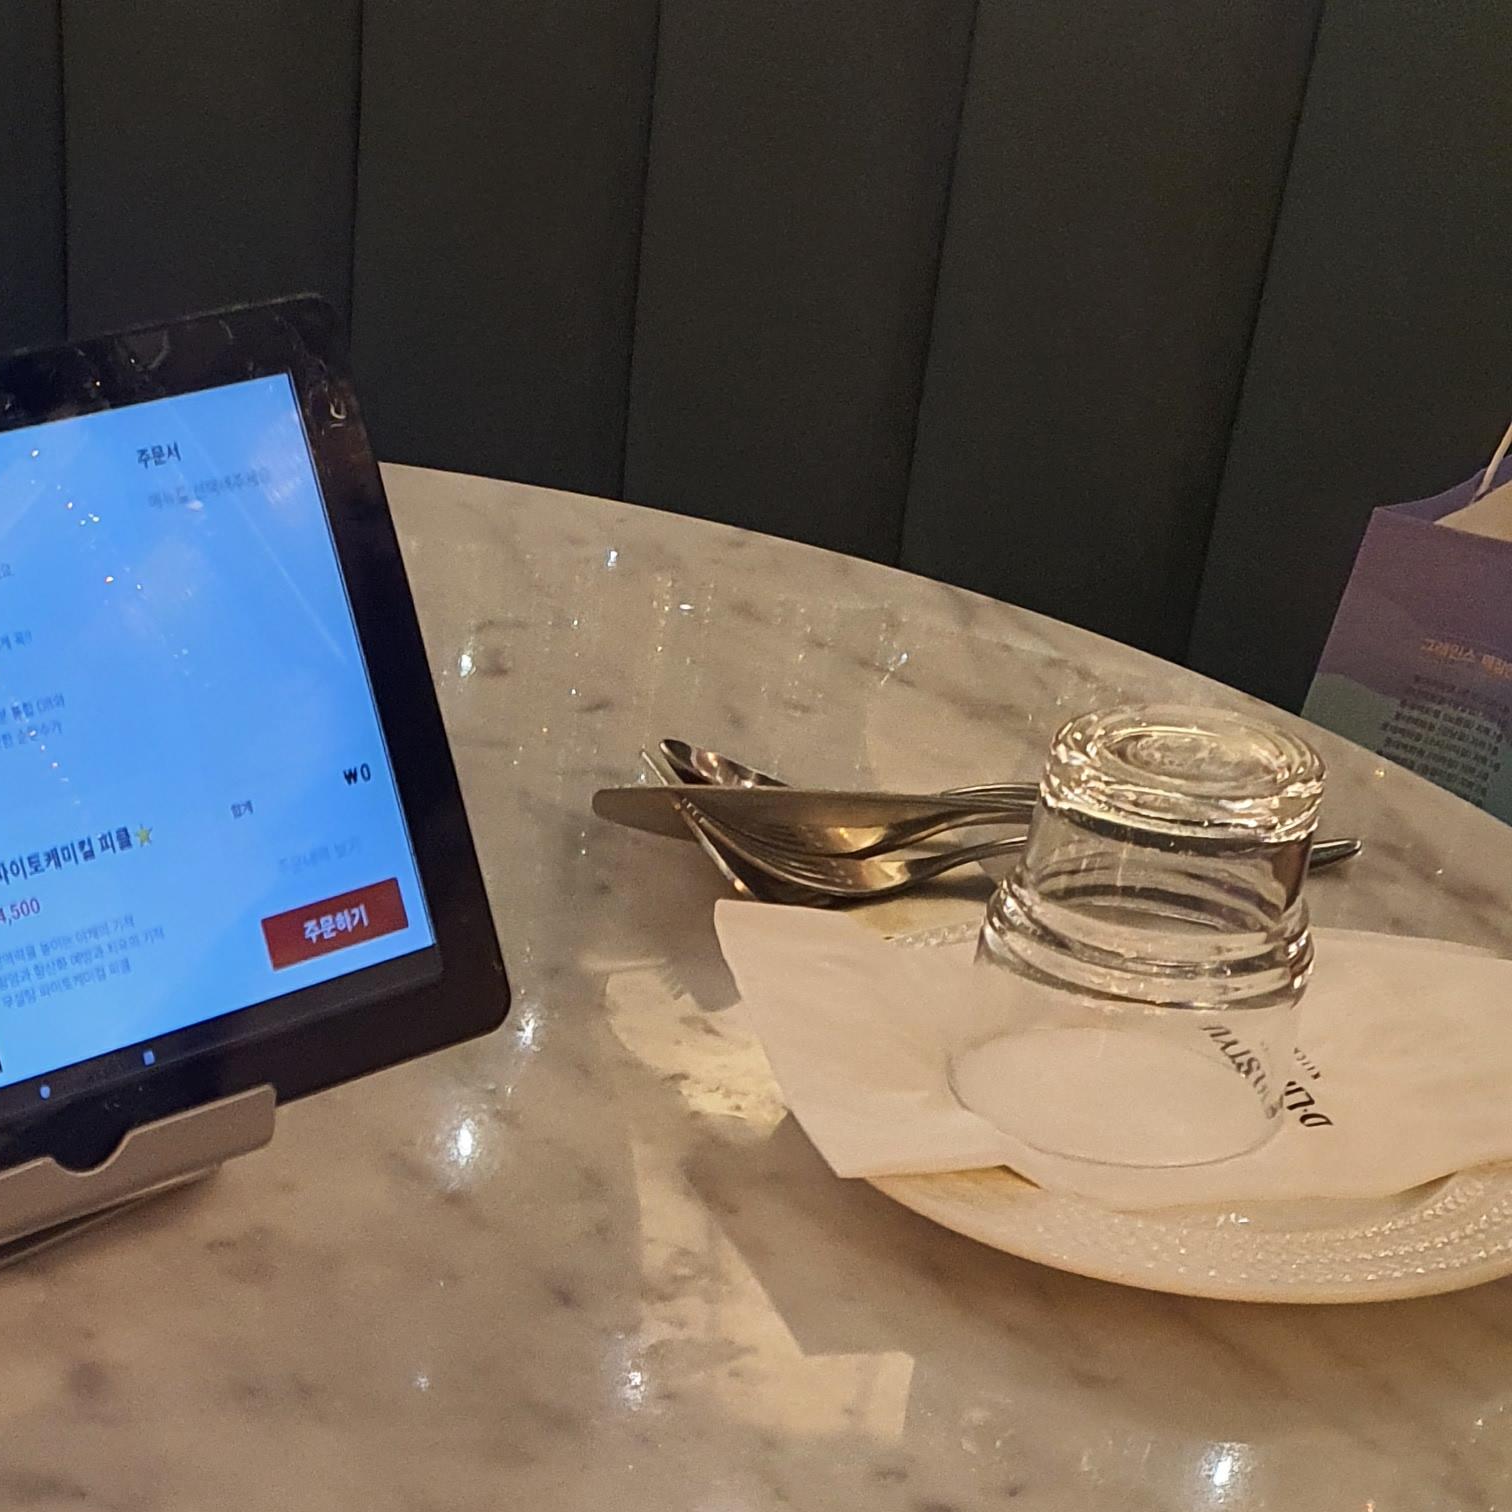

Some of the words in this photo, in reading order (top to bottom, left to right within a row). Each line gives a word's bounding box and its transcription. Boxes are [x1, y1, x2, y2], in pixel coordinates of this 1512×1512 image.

[136, 441, 181, 468] 주문서
[98, 826, 132, 853] 피클
[303, 903, 368, 943] 주문하기
